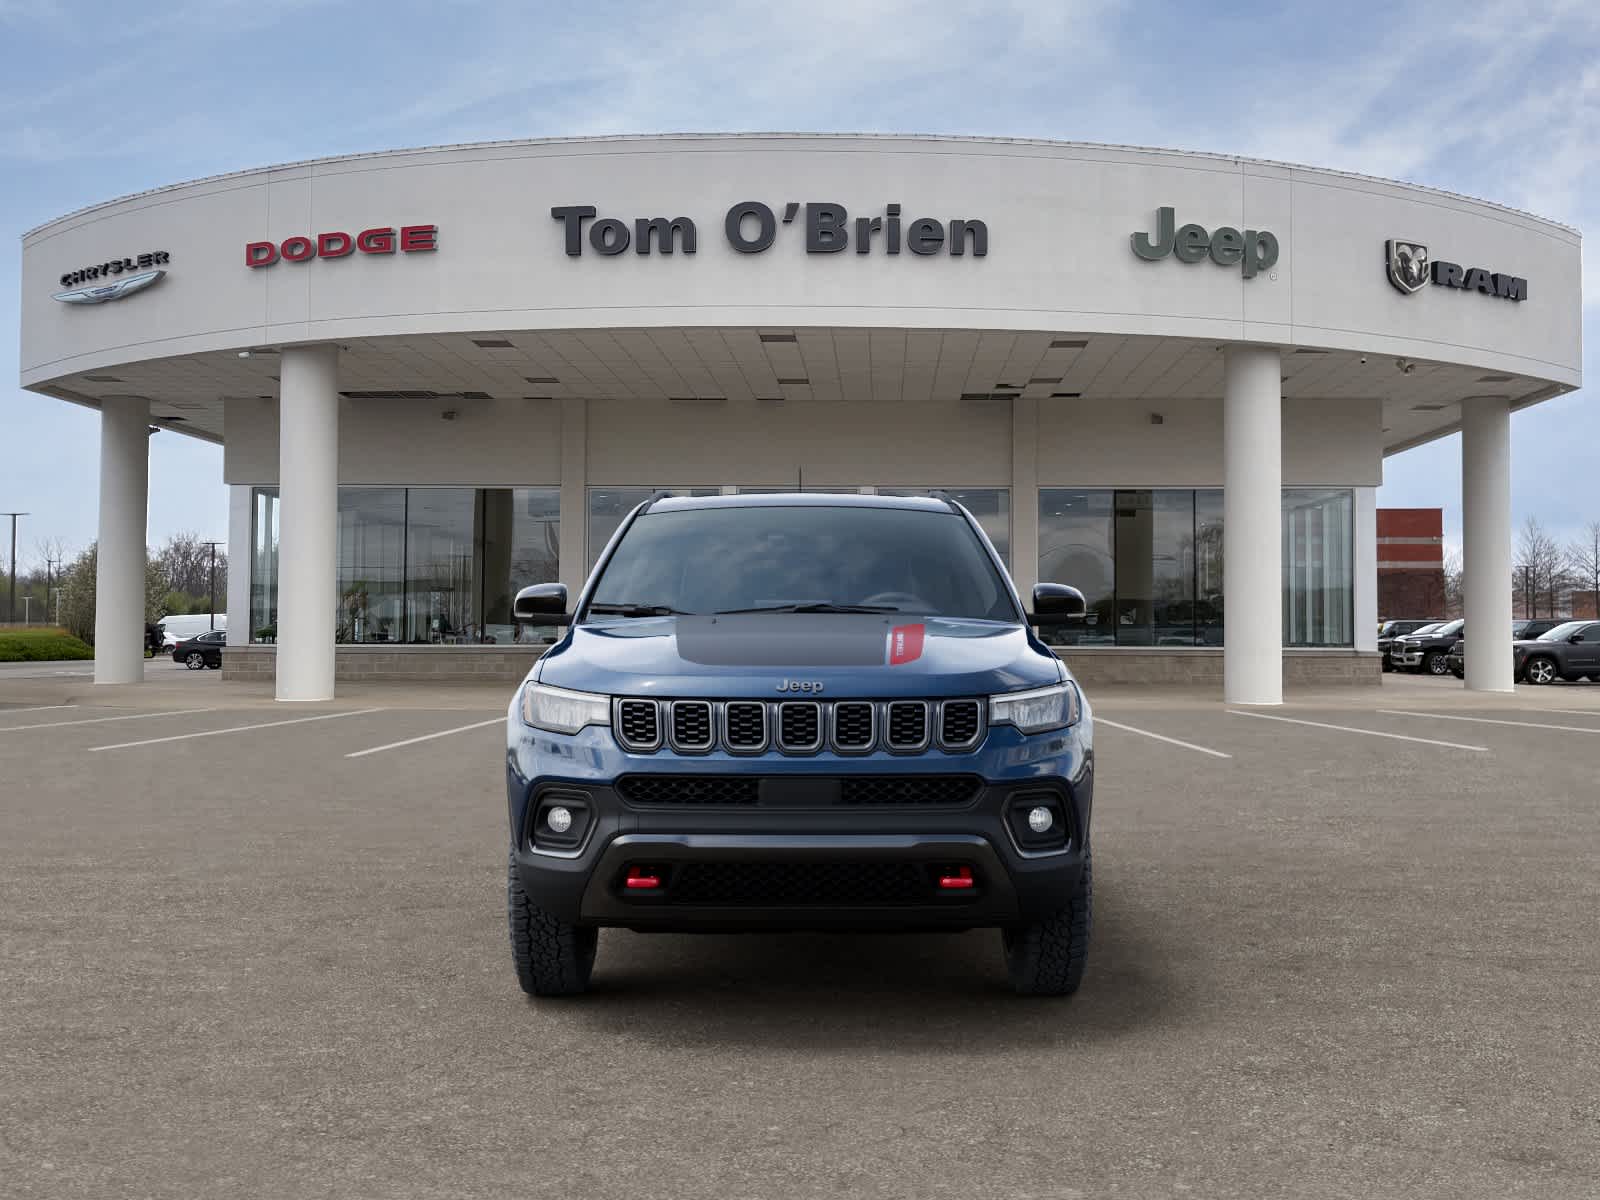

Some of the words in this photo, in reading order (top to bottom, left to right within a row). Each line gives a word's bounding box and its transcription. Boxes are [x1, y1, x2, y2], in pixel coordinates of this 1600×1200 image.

[245, 224, 438, 269] DODGE
[550, 205, 698, 257] Tom
[724, 200, 989, 257] O'Brien
[1130, 206, 1280, 279] Jeep
[60, 250, 170, 287] CHRYSLER
[1430, 260, 1528, 302] RAM
[775, 677, 825, 694] Jeep
